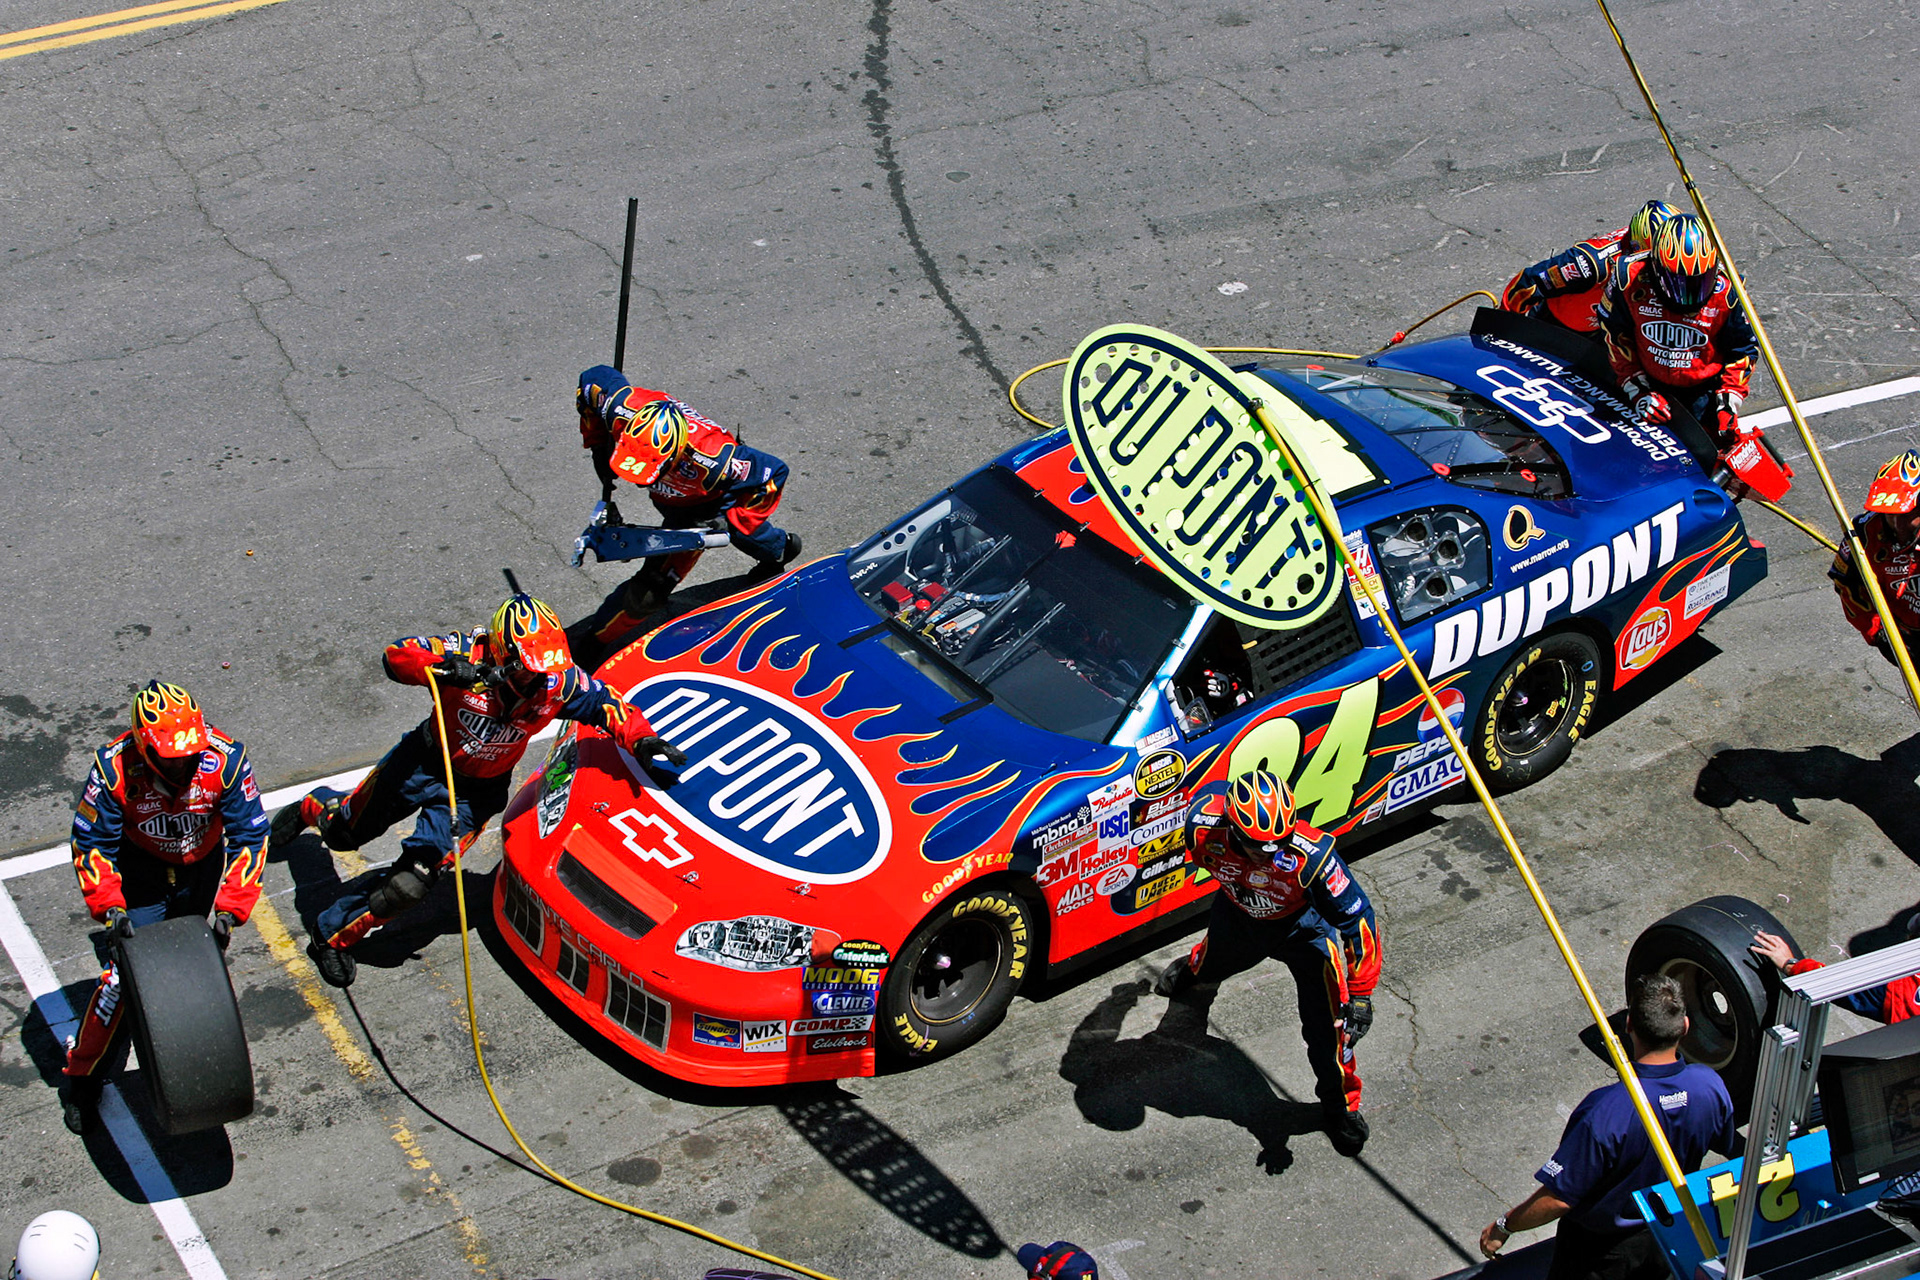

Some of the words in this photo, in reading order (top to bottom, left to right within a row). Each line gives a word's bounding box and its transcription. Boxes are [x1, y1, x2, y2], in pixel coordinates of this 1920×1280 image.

[1639, 306, 1662, 315] GMAC
[1492, 338, 1566, 377] ALLIANCE
[1647, 345, 1700, 360] AUTOMOTIVE
[1654, 356, 1692, 368] FINISHES
[1610, 420, 1669, 462] DuPont
[619, 457, 647, 475] 24
[1872, 492, 1898, 507] 24
[1510, 539, 1570, 573] www.marrow.org
[1428, 501, 1685, 681] DUPONT
[1625, 615, 1667, 665] Lay's
[543, 649, 564, 668] 24
[1567, 680, 1597, 742] EAGLE
[174, 727, 198, 750] 24
[546, 761, 573, 790] 24
[1145, 767, 1175, 786] NEXTEL
[1390, 755, 1464, 800] GMAC
[1148, 784, 1158, 793] CUP
[1148, 792, 1184, 813] BUD
[1033, 818, 1078, 849] mbna
[1100, 810, 1128, 840] USG
[1039, 849, 1079, 887] 3M
[1080, 844, 1128, 874] Holley
[1142, 853, 1185, 880] Gillette
[1103, 877, 1130, 894] SPORTS
[1105, 867, 1129, 888] EA
[1056, 896, 1094, 917] TOOLS
[1057, 882, 1094, 910] MAC
[833, 948, 888, 963] Gatorback
[842, 942, 881, 950] GOODYEAR
[803, 967, 880, 984] MOOG
[816, 993, 870, 1010] CLEVITE
[697, 1022, 738, 1036] SUNOCO
[744, 1022, 783, 1041] WIX
[794, 1018, 852, 1032] COMP
[894, 1012, 939, 1053] EAGLE
[745, 1039, 784, 1051] FILTERS
[812, 1036, 867, 1049] Edelbrock
